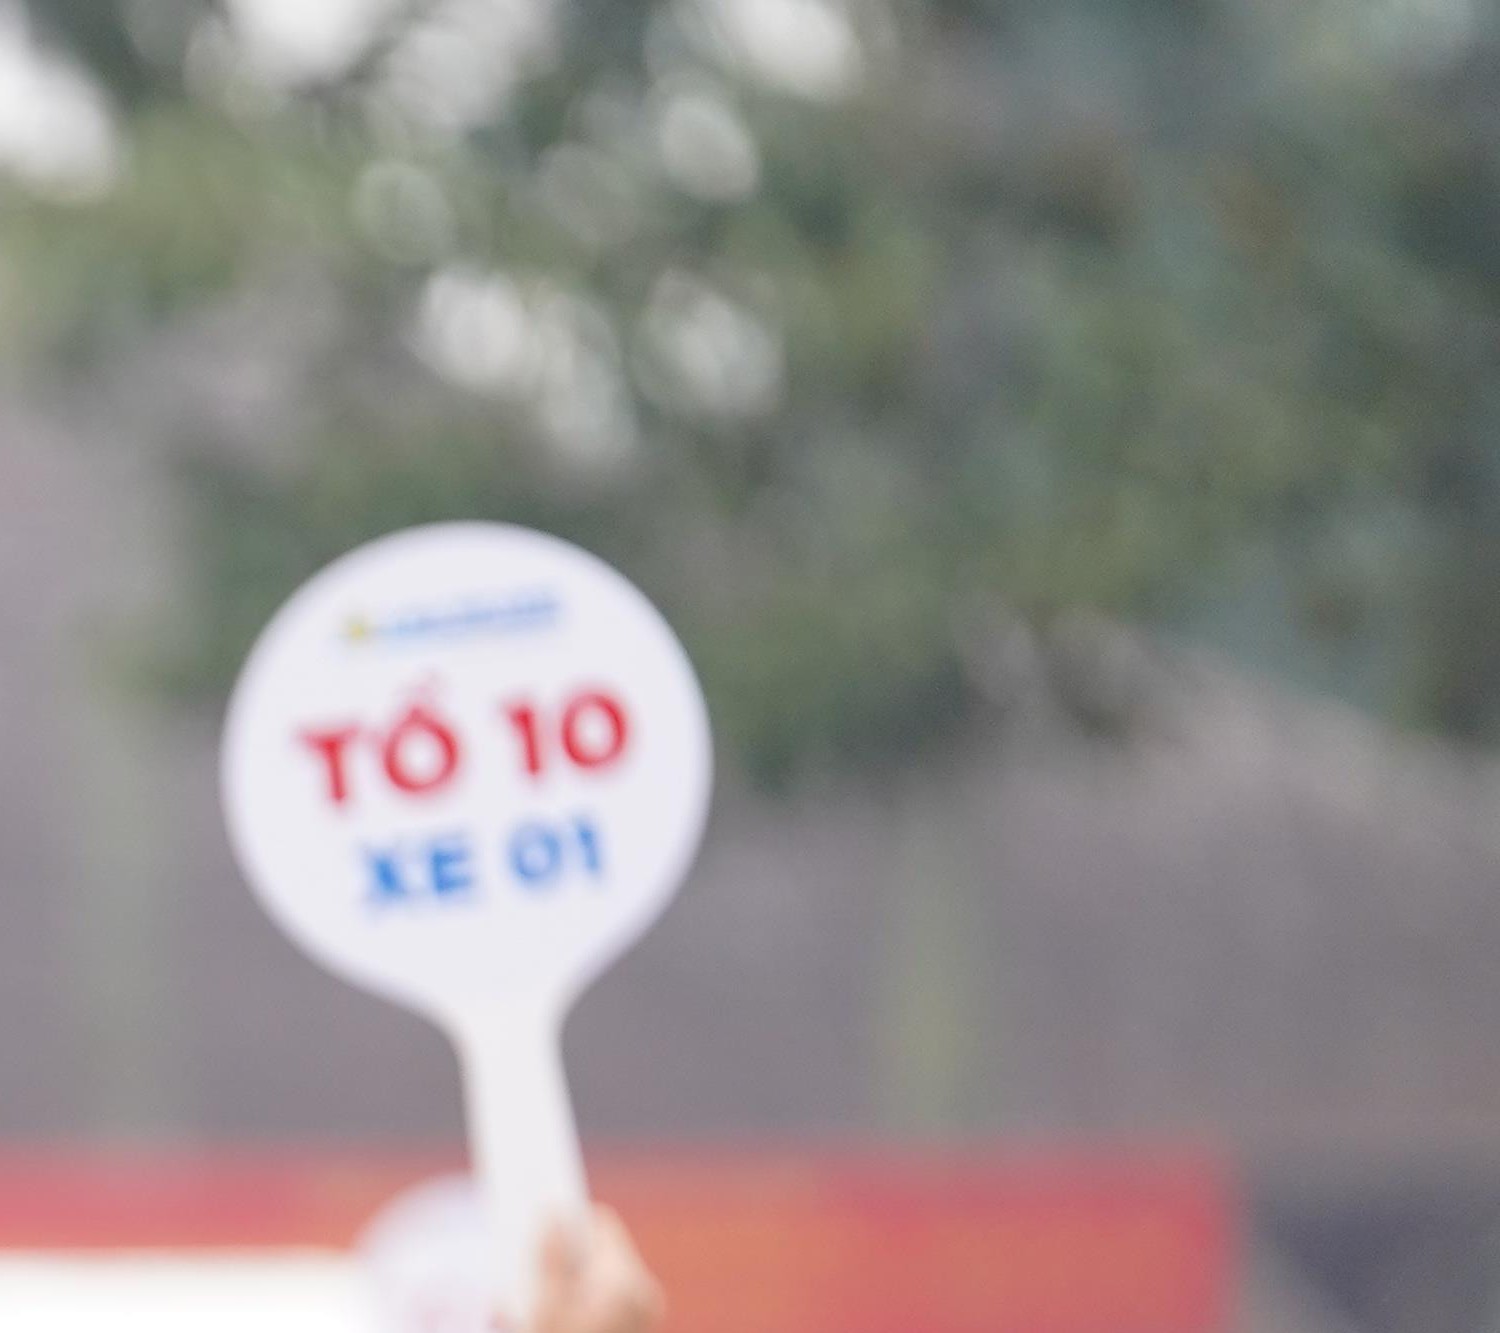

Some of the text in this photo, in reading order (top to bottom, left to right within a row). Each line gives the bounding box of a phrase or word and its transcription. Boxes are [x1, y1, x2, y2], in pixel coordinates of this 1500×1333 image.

[503, 688, 628, 780] 10
[363, 814, 604, 915] XE 01
